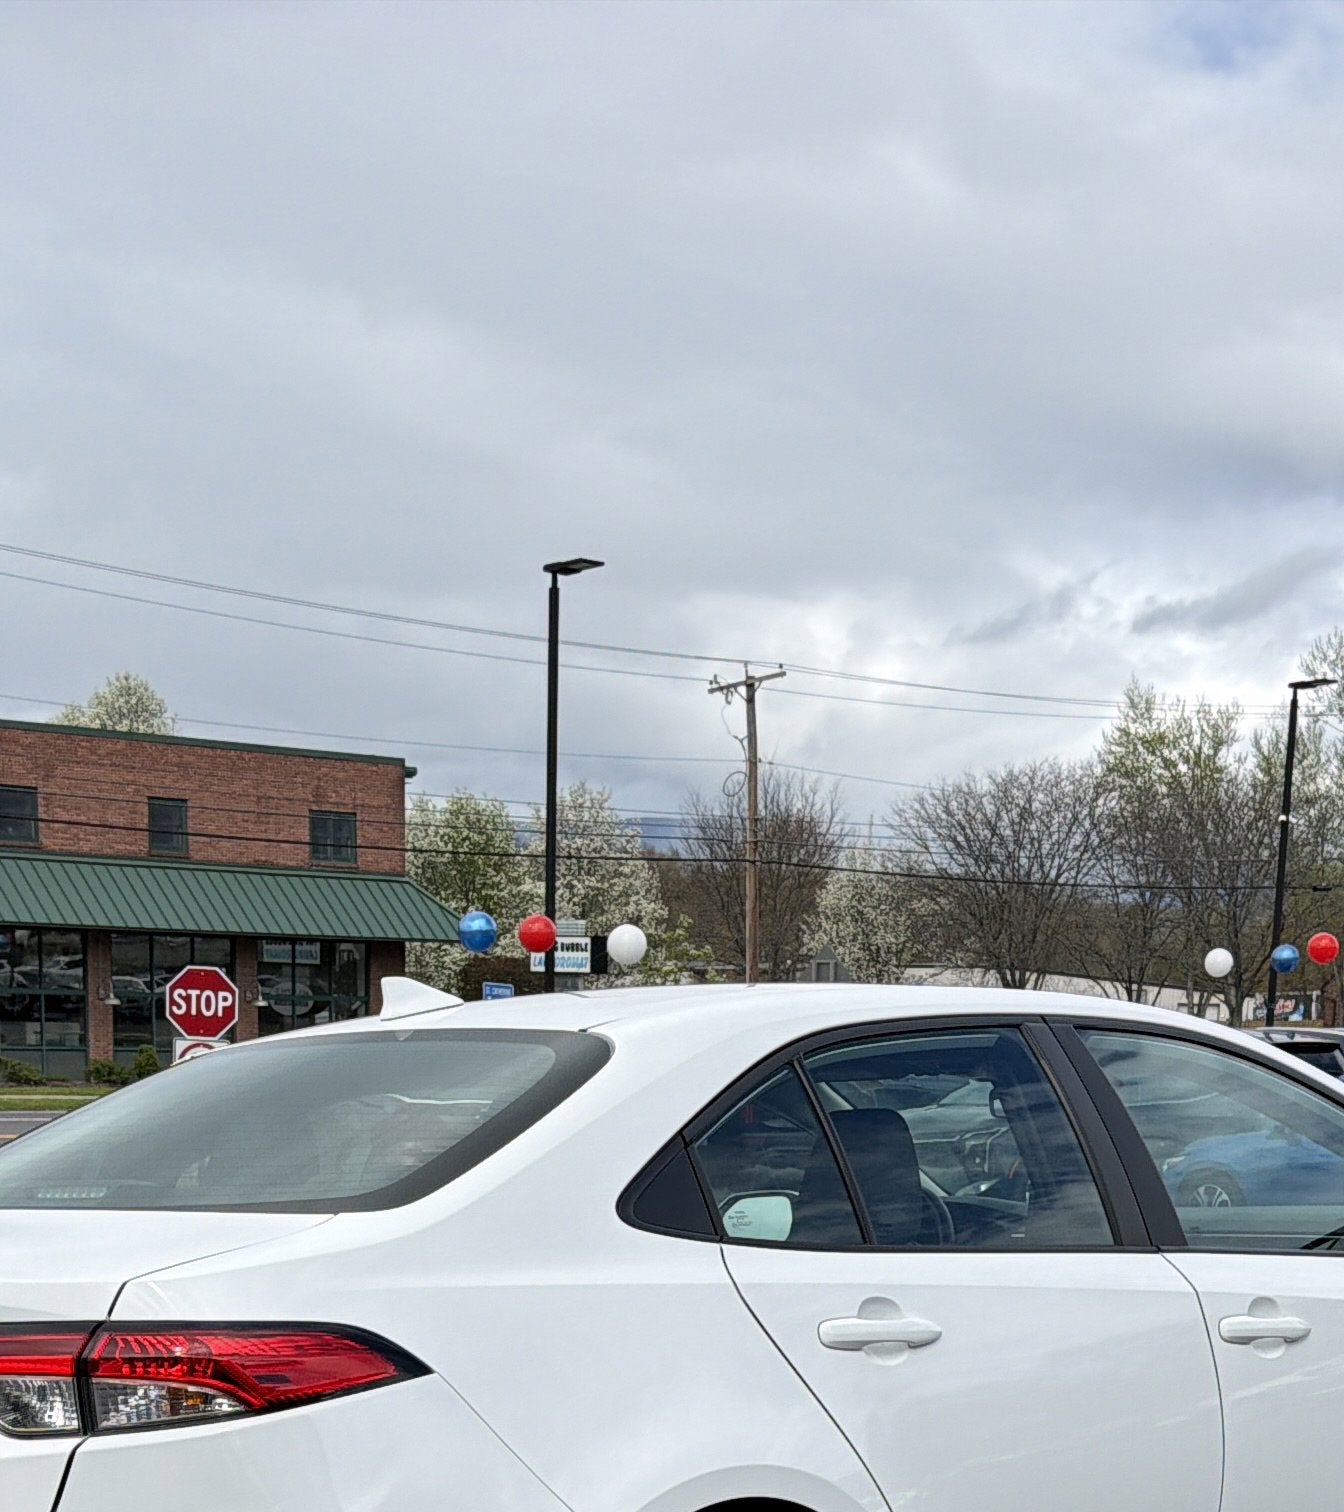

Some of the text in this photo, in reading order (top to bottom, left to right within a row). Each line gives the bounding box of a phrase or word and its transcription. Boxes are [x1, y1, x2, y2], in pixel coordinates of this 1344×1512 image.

[560, 942, 589, 953] BUBBLE
[533, 956, 588, 969] LADROMAT
[171, 988, 233, 1018] STOP
